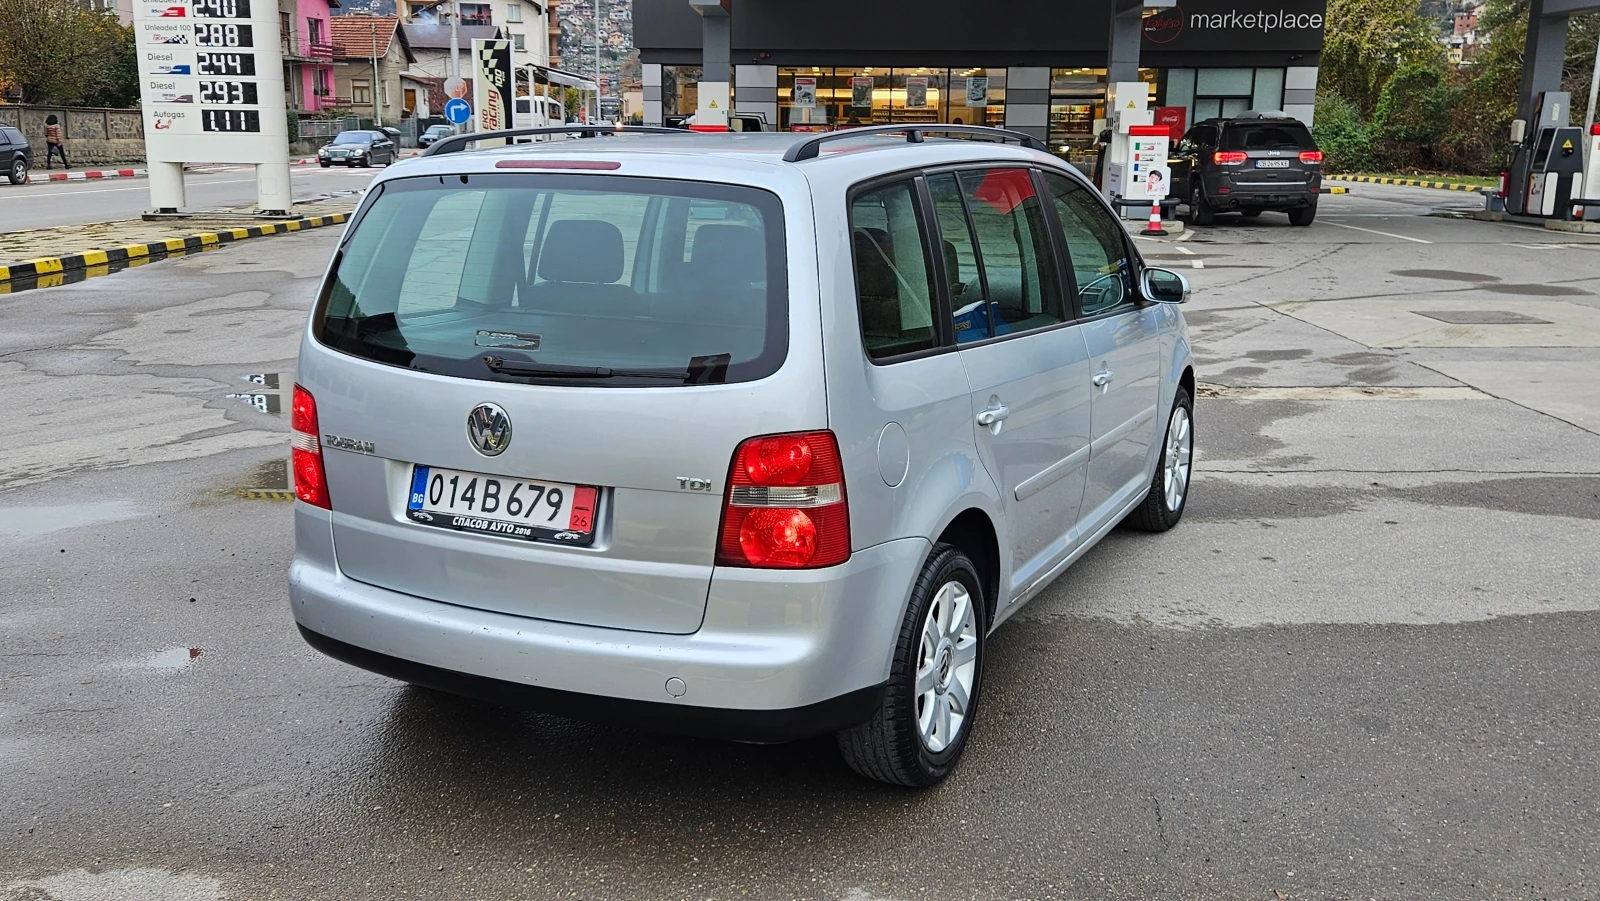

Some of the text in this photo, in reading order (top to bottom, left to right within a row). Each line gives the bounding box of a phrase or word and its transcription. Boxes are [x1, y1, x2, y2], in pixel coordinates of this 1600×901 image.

[193, 0, 237, 18] 2.40
[1190, 9, 1323, 33] marketplace
[195, 24, 239, 47] 2.88
[147, 53, 173, 61] Diesel
[197, 53, 241, 74] 2.44
[494, 68, 503, 88] 100
[200, 82, 243, 104] 2.93
[153, 110, 185, 119] Autogas
[488, 89, 500, 131] racing
[210, 111, 246, 131] 1.11
[325, 434, 376, 455] TOURAN
[676, 476, 712, 491] TDI
[412, 473, 588, 527] BG 014B679 26
[452, 516, 531, 536] СПАСОВ АУТО 2016
